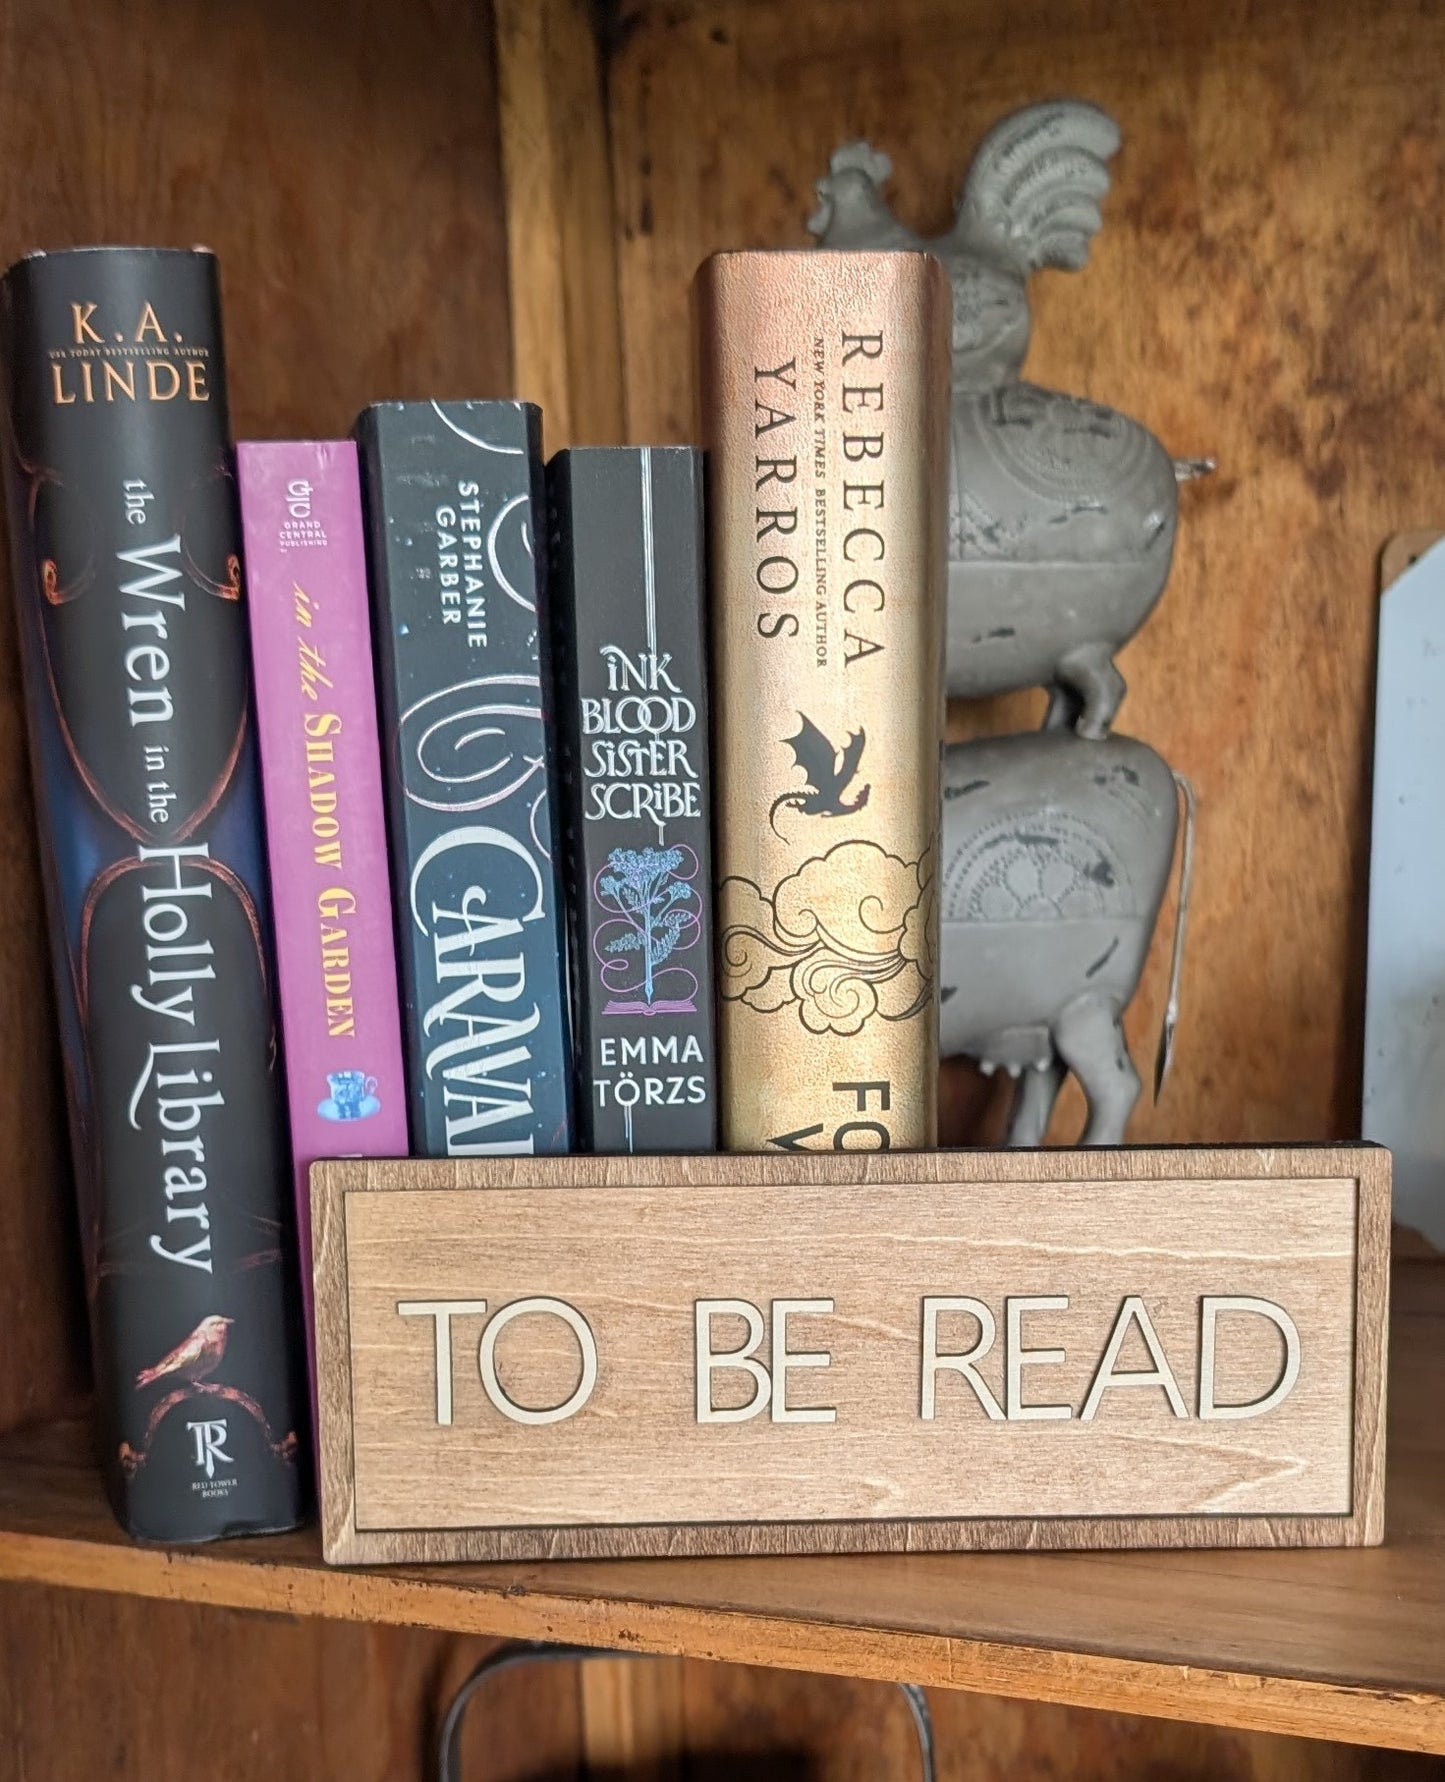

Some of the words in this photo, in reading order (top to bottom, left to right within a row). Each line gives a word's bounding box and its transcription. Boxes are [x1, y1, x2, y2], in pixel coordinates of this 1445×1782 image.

[814, 337, 825, 375] NEW
[51, 359, 210, 405] LINDE
[814, 380, 826, 424] YORK
[814, 428, 826, 479] TIMES
[123, 478, 155, 526] the
[754, 356, 800, 639] YARROS
[841, 329, 885, 669] REBECCA
[279, 529, 328, 540] CENTRAL
[284, 520, 321, 530] GRAND
[815, 488, 828, 594] BESTSELLING
[435, 504, 462, 625] GARBER
[458, 480, 488, 649] STEPHANIE
[293, 580, 320, 628] in
[115, 533, 186, 727] Wren
[816, 600, 828, 668] AUTHOR
[298, 636, 334, 701] the
[581, 696, 696, 735] BLOOD
[143, 744, 169, 772] in
[147, 780, 177, 824] the
[130, 842, 217, 1027] Holly
[600, 1034, 704, 1066] EMMA
[593, 1071, 706, 1107] TÖRZS
[128, 1038, 225, 1275] Library
[398, 1296, 598, 1425] TO
[695, 1298, 837, 1424] BE
[920, 1295, 1301, 1422] READ
